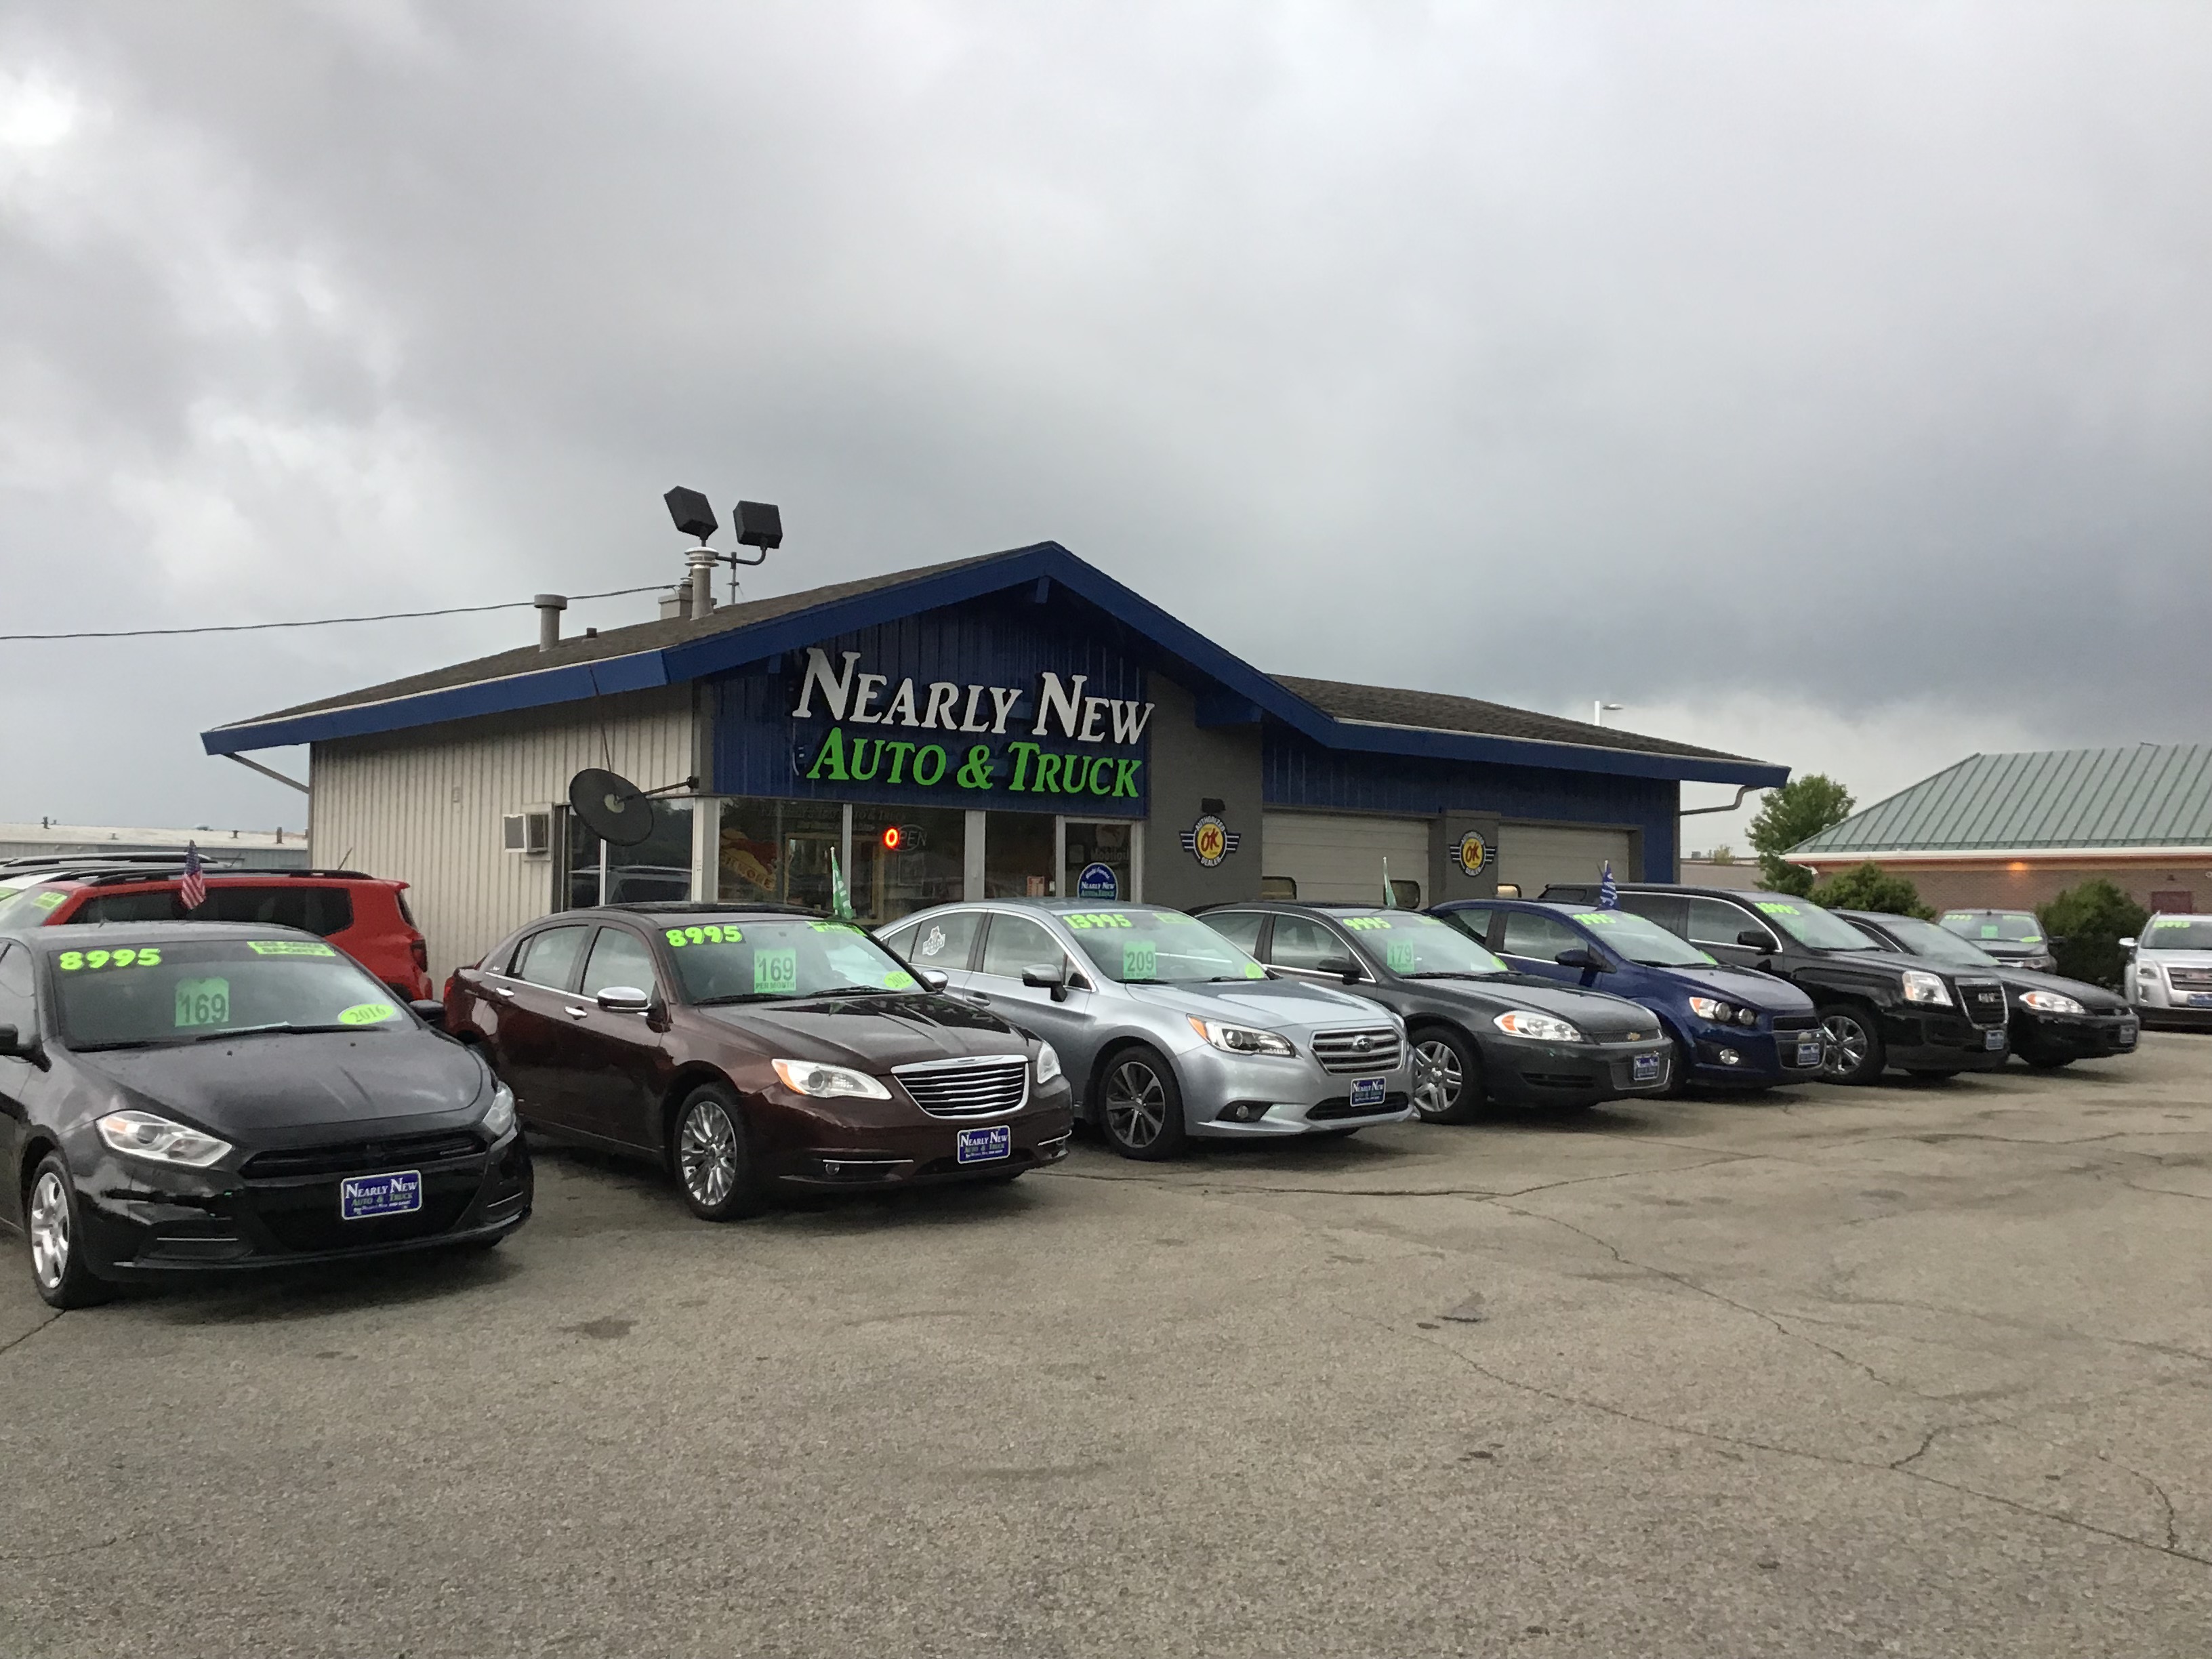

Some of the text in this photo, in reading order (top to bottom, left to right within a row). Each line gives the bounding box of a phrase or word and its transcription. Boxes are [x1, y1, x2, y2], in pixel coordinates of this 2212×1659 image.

[792, 648, 1155, 744] NEARLY NEW
[806, 727, 1143, 798] AUTO & TRUCK
[884, 827, 927, 847] OPEN
[1201, 828, 1219, 851] OK
[1466, 842, 1479, 863] OK
[1063, 914, 1132, 928] 13995
[1343, 917, 1391, 930] 9995
[666, 926, 743, 947] 8995
[60, 948, 162, 970] 8995
[350, 1005, 386, 1022] 2016
[960, 1131, 1008, 1147] NEARLY NEW
[346, 1178, 417, 1198] NEARLY NEW
